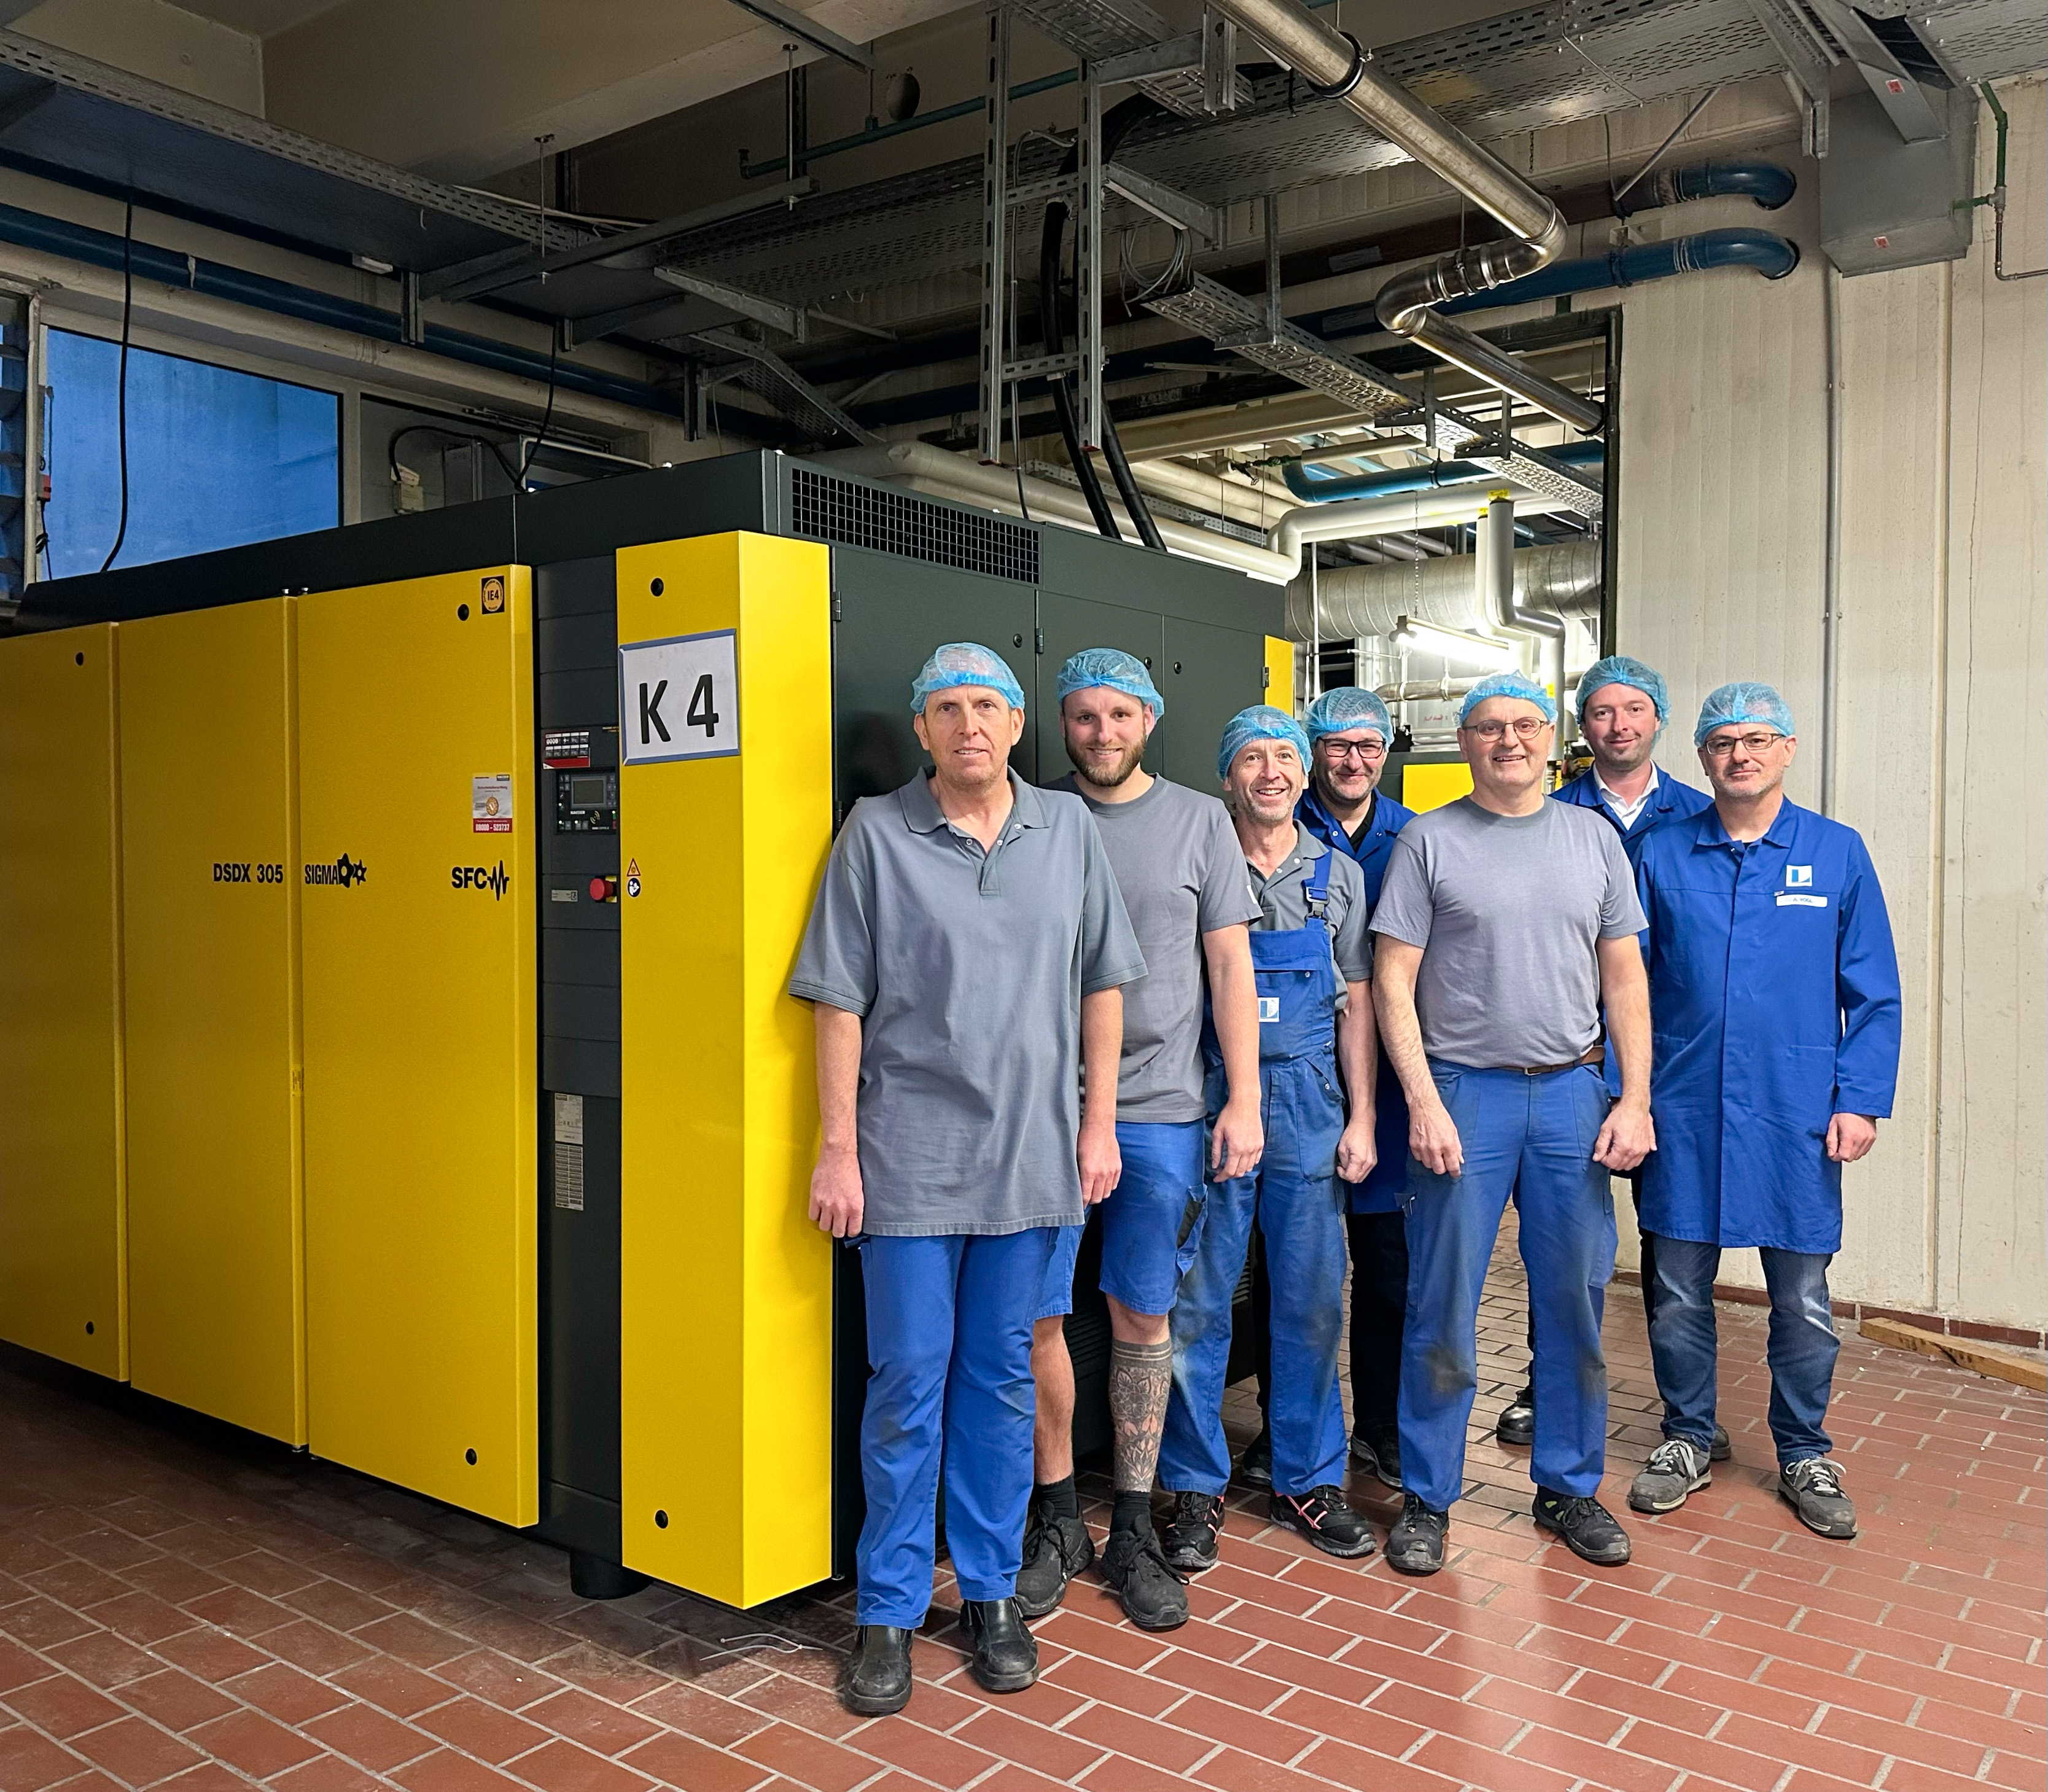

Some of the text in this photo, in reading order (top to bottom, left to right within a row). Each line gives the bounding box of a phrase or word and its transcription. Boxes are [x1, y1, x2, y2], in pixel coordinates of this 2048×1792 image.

[487, 590, 499, 601] IE4
[639, 674, 719, 744] K 4
[213, 863, 283, 884] DSDX 305
[305, 864, 338, 885] SIGMA
[451, 867, 488, 889] SFC
